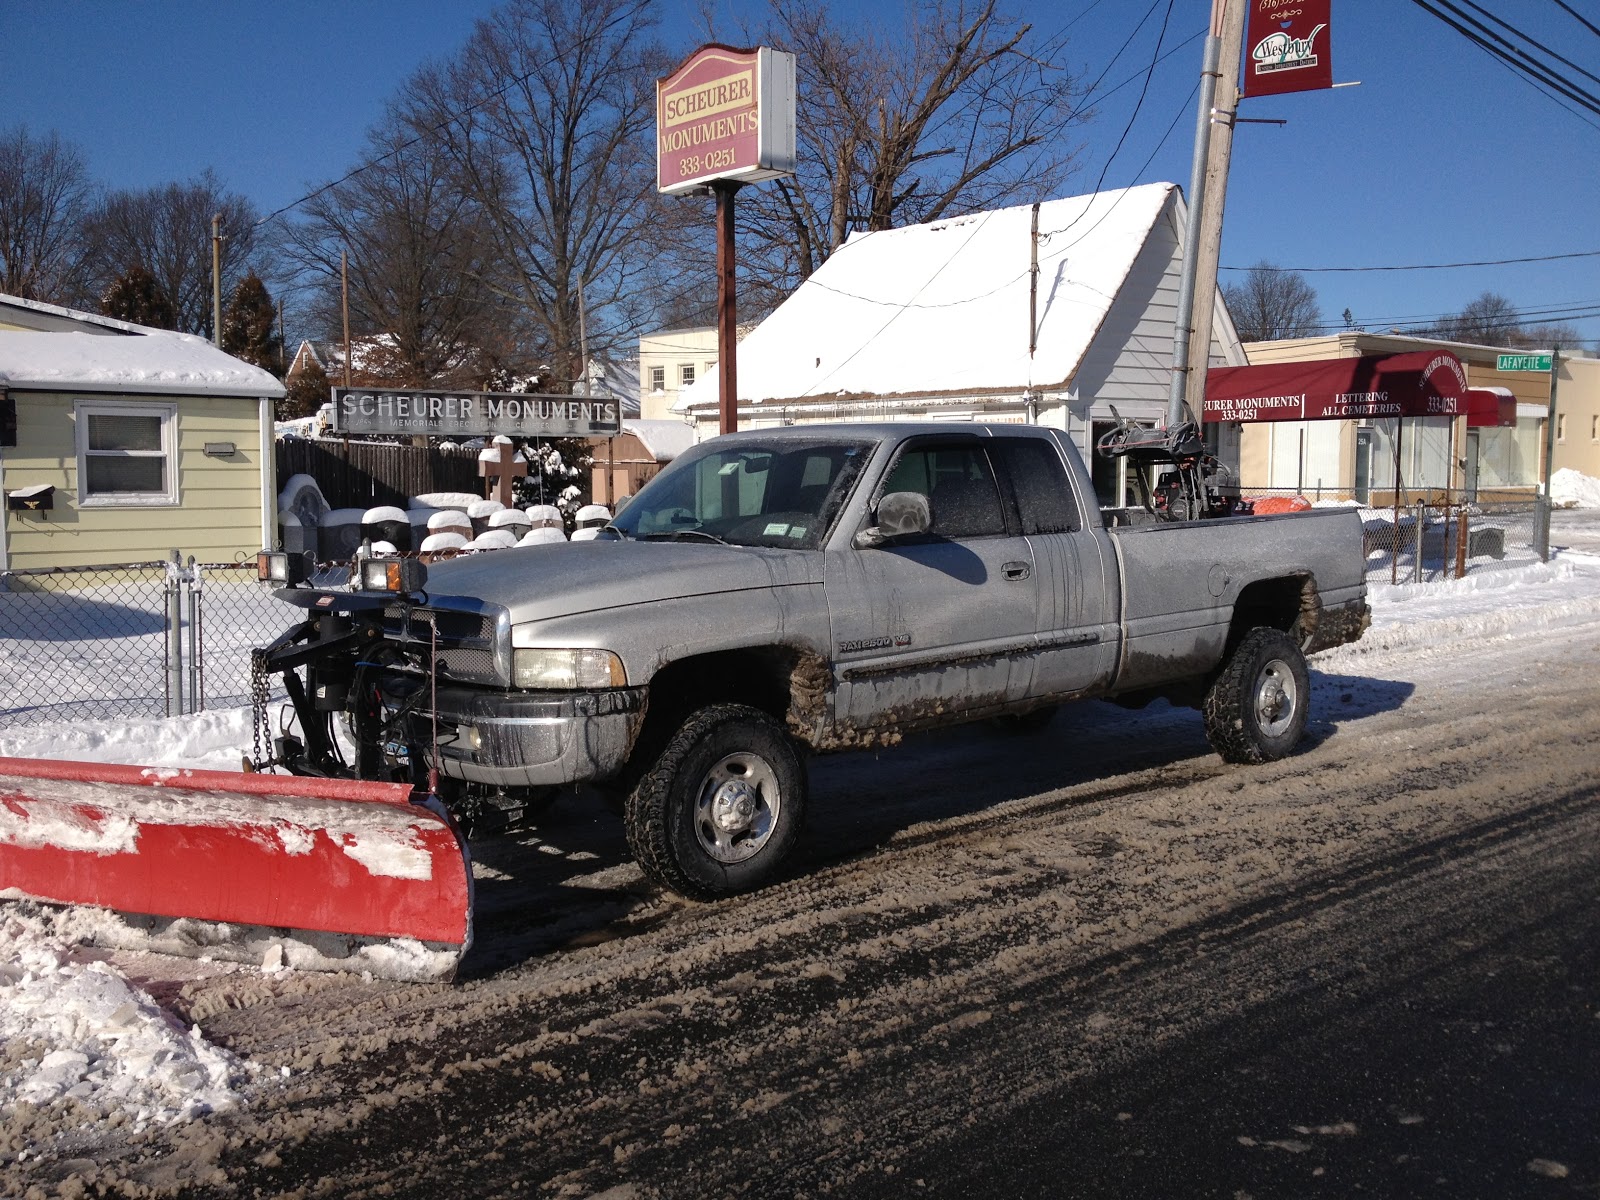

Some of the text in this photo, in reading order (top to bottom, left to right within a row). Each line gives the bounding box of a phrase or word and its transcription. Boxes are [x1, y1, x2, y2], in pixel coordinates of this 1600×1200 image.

[1260, 37, 1313, 57] Westbury
[666, 77, 750, 120] SCHEURER
[661, 109, 758, 154] MONUMENTS
[679, 147, 736, 177] 333-0251
[1499, 356, 1551, 369] LAFAYETTE AVE
[1442, 355, 1467, 393] MONUMENTS
[1235, 395, 1300, 410] MONUMENTS
[1335, 392, 1388, 404] LETTERING
[1427, 396, 1457, 413] 333-0251
[342, 394, 616, 422] SCHEURER MONUMENTS
[1221, 409, 1258, 421] 333-0251
[1321, 403, 1401, 416] ALL CEMETERIES
[389, 419, 443, 427] MEMORIALS
